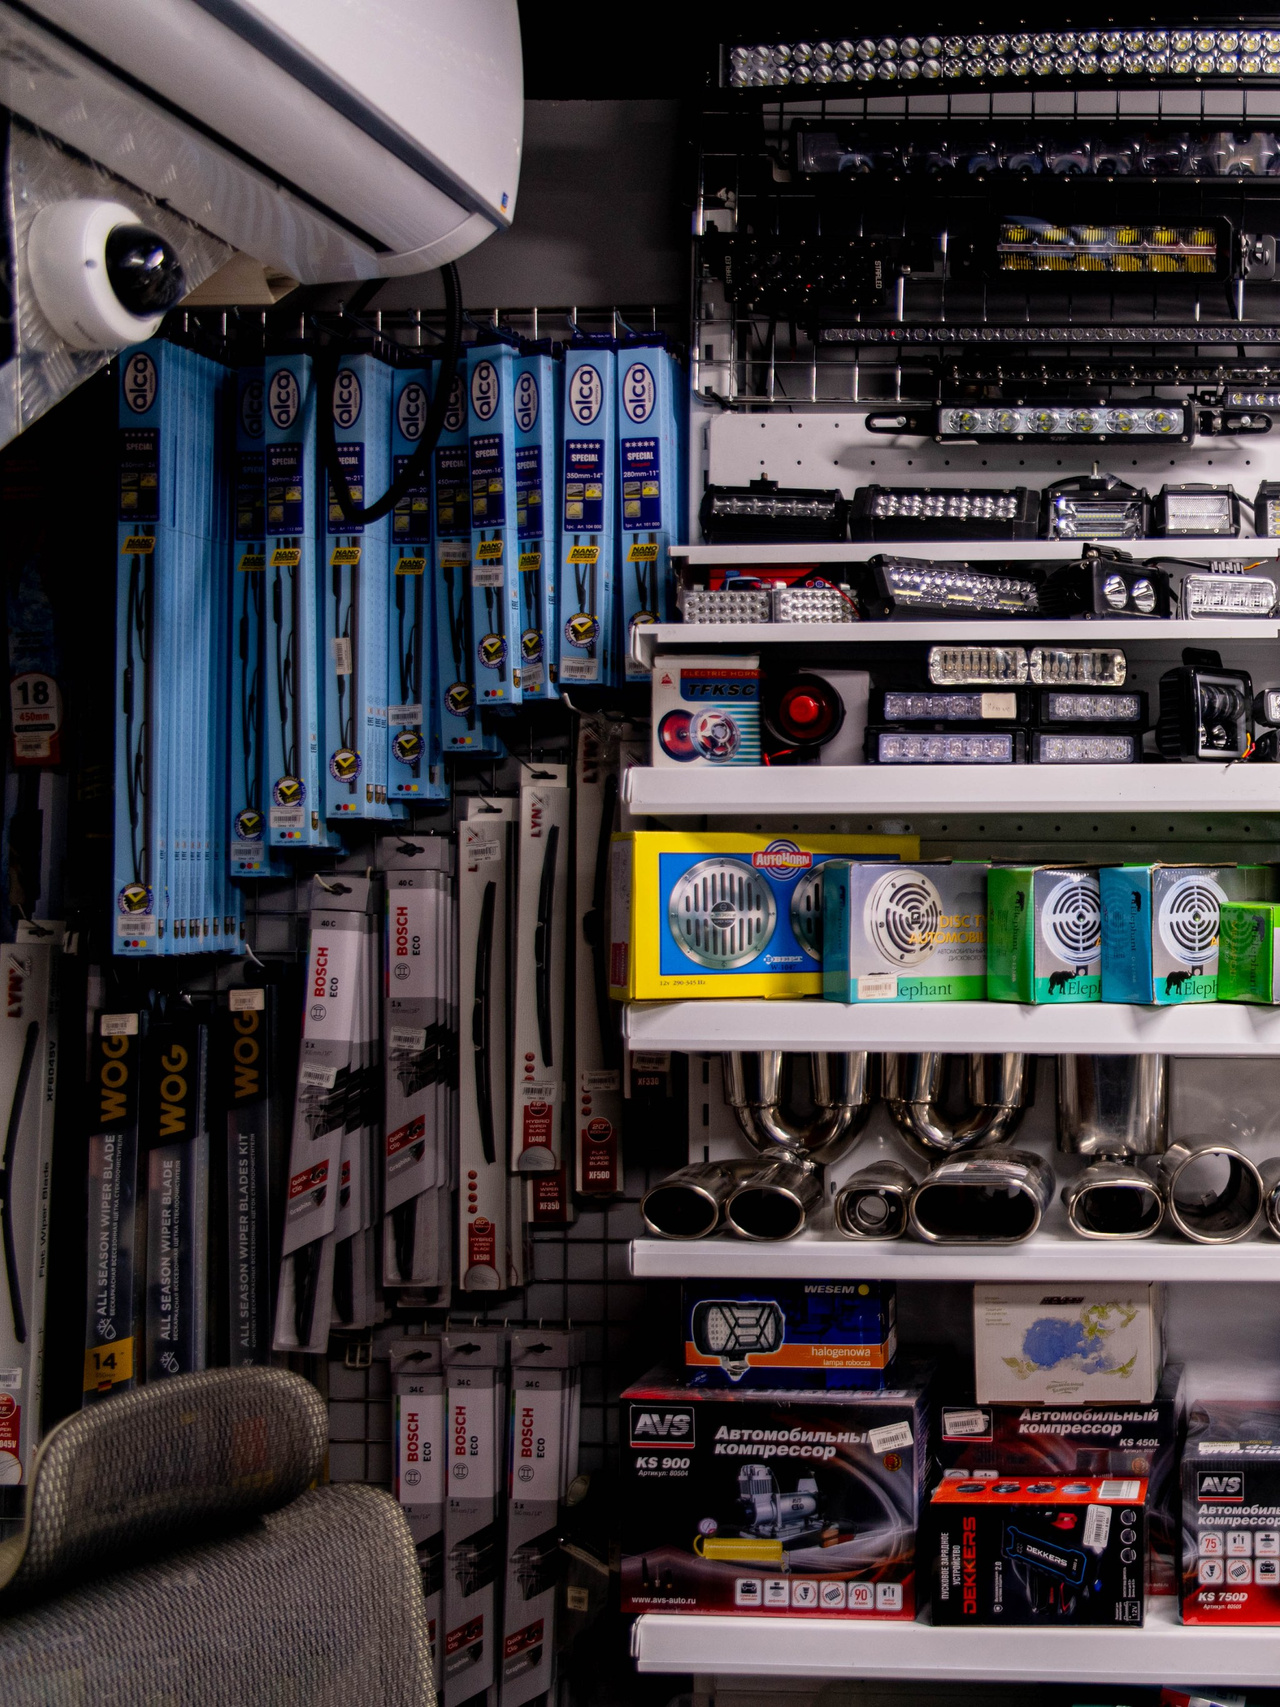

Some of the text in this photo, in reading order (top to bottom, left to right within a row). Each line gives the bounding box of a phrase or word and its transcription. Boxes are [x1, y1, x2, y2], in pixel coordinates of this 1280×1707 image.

[724, 256, 732, 284] STARLED
[130, 358, 148, 410] alca
[475, 366, 491, 417] alca
[277, 373, 292, 426] alca
[335, 373, 352, 426] alca
[518, 376, 532, 428] alca
[575, 370, 594, 421] alca
[628, 369, 647, 420] alca
[403, 387, 420, 439] alca
[126, 443, 153, 451] SPECIAL
[475, 449, 498, 458] SPECIAL
[271, 457, 297, 465] SPECIAL
[441, 460, 467, 468] SPECIAL
[571, 454, 599, 462] SPECIAL
[627, 452, 654, 461] SPECIAL
[472, 466, 504, 475] 400mm-16"
[516, 461, 538, 470] SPECIAL
[566, 471, 603, 480] 350mm-14"
[623, 470, 660, 478] 280mm-11"
[274, 549, 301, 557] NANO
[335, 549, 360, 557] NANO
[574, 548, 599, 556] NANO
[17, 681, 49, 705] 18
[688, 684, 756, 696] TFKSC
[20, 712, 50, 721] 450mm
[398, 879, 406, 887] 40
[321, 920, 330, 928] 40
[939, 915, 970, 929] DISC
[396, 906, 409, 956] BOSCH
[908, 932, 987, 945] AUTOMOBIL
[412, 935, 421, 956] ECO
[314, 946, 329, 998] BOSCH
[330, 977, 339, 998] ECO
[896, 982, 952, 1000] lephant
[233, 1010, 260, 1099] WOG
[101, 1035, 130, 1123] WOG
[160, 1044, 188, 1137] WOG
[528, 1135, 547, 1143] LX400
[589, 1170, 610, 1180] XF500
[173, 1160, 181, 1224] СТЕКЛООЧИСТИТЕЛЯ
[539, 1201, 560, 1210] XF350
[97, 1134, 116, 1316] ALL SEASON WIPER BLADE
[238, 1133, 250, 1348] ALL SEASON WIPER BLADES KIT
[160, 1160, 173, 1340] ALL SEASON WIPER BLADE
[804, 1285, 855, 1294] WESEM
[811, 1346, 871, 1358] halogenowa
[93, 1352, 117, 1370] 14
[823, 1358, 871, 1368] lampa robocza
[1018, 1408, 1160, 1422] Автомобильный
[455, 1406, 466, 1456] BOSCH
[521, 1407, 534, 1458] BOSCH
[634, 1413, 691, 1436] AVS
[1018, 1422, 1122, 1436] компрессор
[407, 1411, 419, 1462] BOSCH
[714, 1426, 874, 1445] Автомобильны
[1119, 1438, 1160, 1447] KS 450L
[423, 1441, 431, 1462] ECO
[470, 1435, 479, 1456] ECO
[537, 1437, 545, 1458] ECO
[714, 1443, 836, 1459] компрессор
[636, 1457, 690, 1469] KS 900
[638, 1469, 668, 1477] Артикул:
[1200, 1476, 1241, 1493] AVS
[1205, 1538, 1217, 1549] 75
[1026, 1544, 1068, 1567] DEKKERS
[940, 1532, 950, 1600] ПУСКОВОЕ ЗАРЯДНОЕ
[952, 1544, 961, 1586] УСТРОЙСТВО
[963, 1516, 976, 1614] DEKKERS
[994, 1561, 1002, 1571] 2.0
[631, 1596, 696, 1605] www.avs-auto.ru
[855, 1589, 868, 1600] 90
[1198, 1592, 1248, 1601] KS 750D
